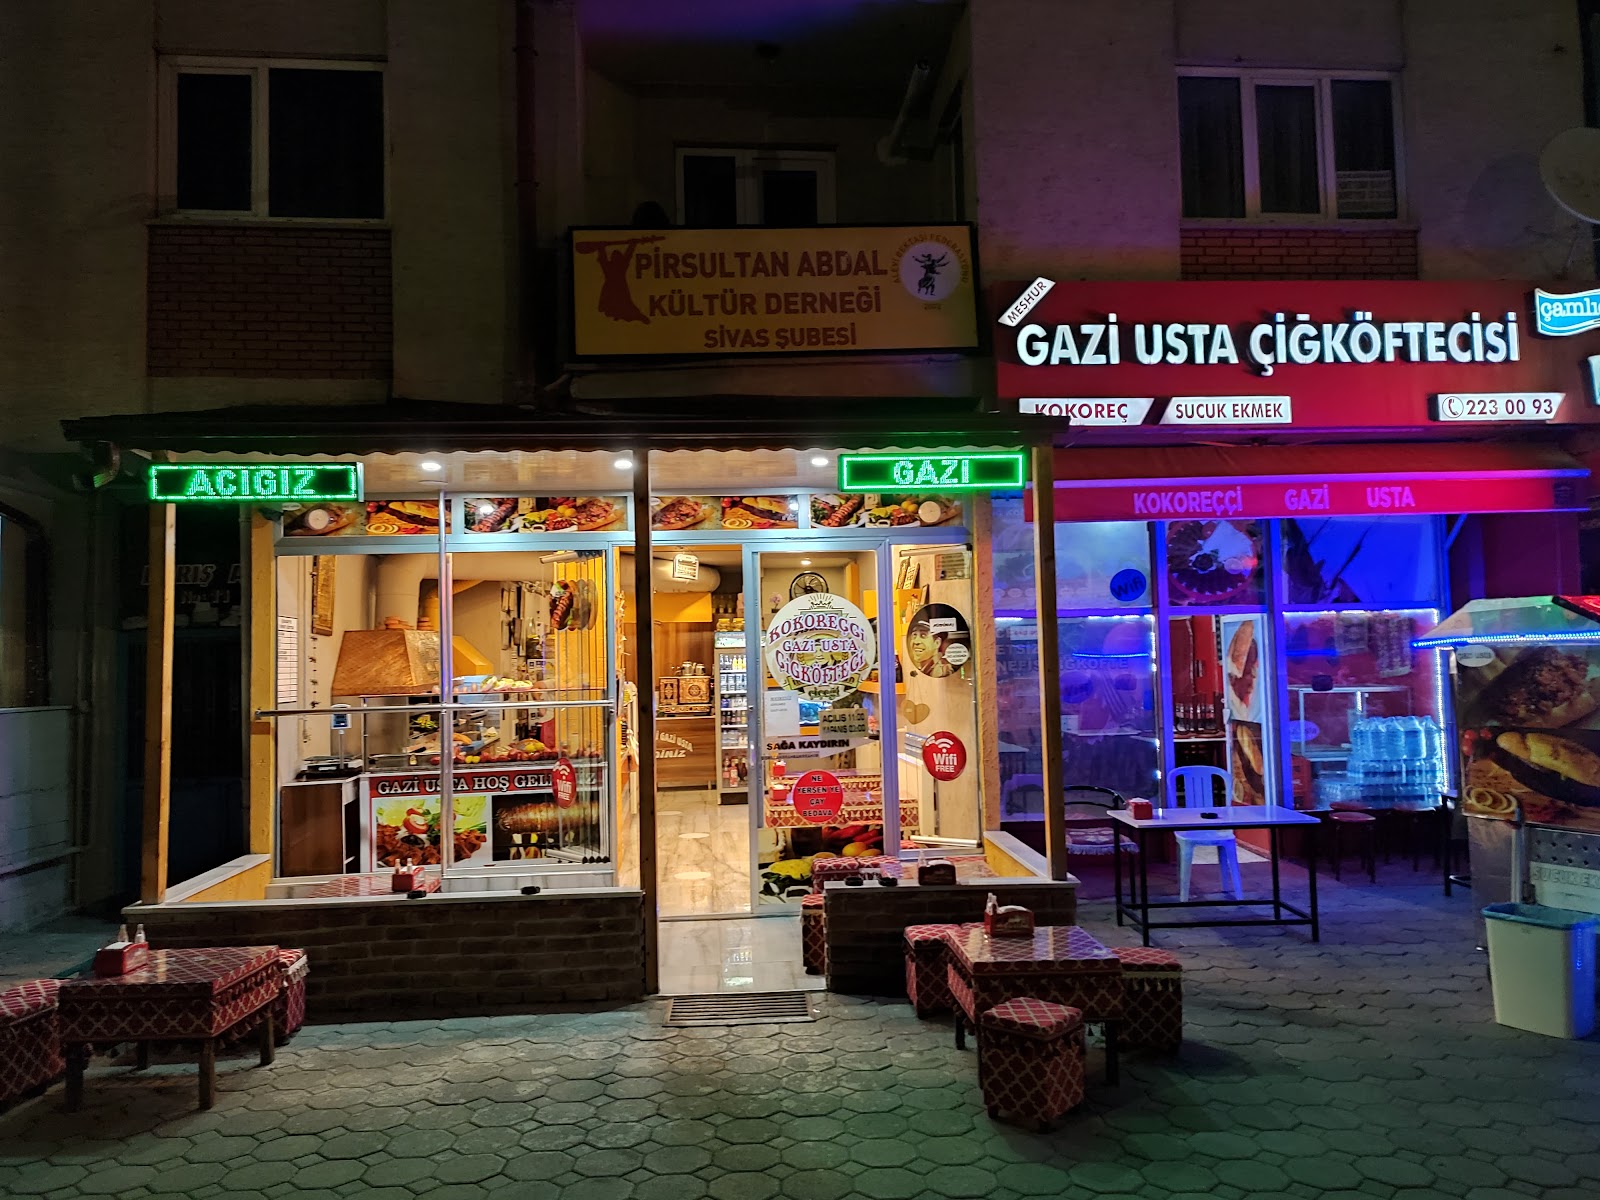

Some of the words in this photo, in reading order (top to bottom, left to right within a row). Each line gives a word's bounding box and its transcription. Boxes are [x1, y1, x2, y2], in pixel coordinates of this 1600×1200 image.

[635, 247, 789, 280] PİRSULTAN
[797, 249, 888, 277] ABDAL
[649, 289, 757, 317] KÜLTÜR
[765, 286, 882, 314] DERNEĞİ
[1007, 280, 1048, 324] MEŞHUR
[704, 325, 770, 348] SİVAS
[775, 323, 857, 349] ŞUBESİ
[1017, 313, 1120, 366] GAZİ
[1134, 324, 1239, 365] USTA
[1250, 311, 1521, 377] ÇİĞKÖFTECİSİ
[1035, 403, 1128, 423] KOKOREÇ
[1175, 403, 1227, 419] SUCUK
[1232, 402, 1284, 418] EKMEK
[1466, 399, 1498, 415] 223
[1505, 399, 1525, 415] 00
[1532, 398, 1553, 415] 93
[1133, 485, 1243, 516] KOKOREÇÇİ
[1284, 484, 1330, 510] GAZİ
[1366, 486, 1416, 509] USTA
[821, 639, 858, 651] USTA
[766, 740, 796, 751] SAĞA
[799, 738, 850, 749] KAYDIRIN
[933, 753, 958, 766] Wifi
[935, 765, 955, 773] FREE
[377, 777, 419, 795] GAZİ
[473, 775, 510, 792] HOŞ
[797, 786, 827, 794] YERSEN
